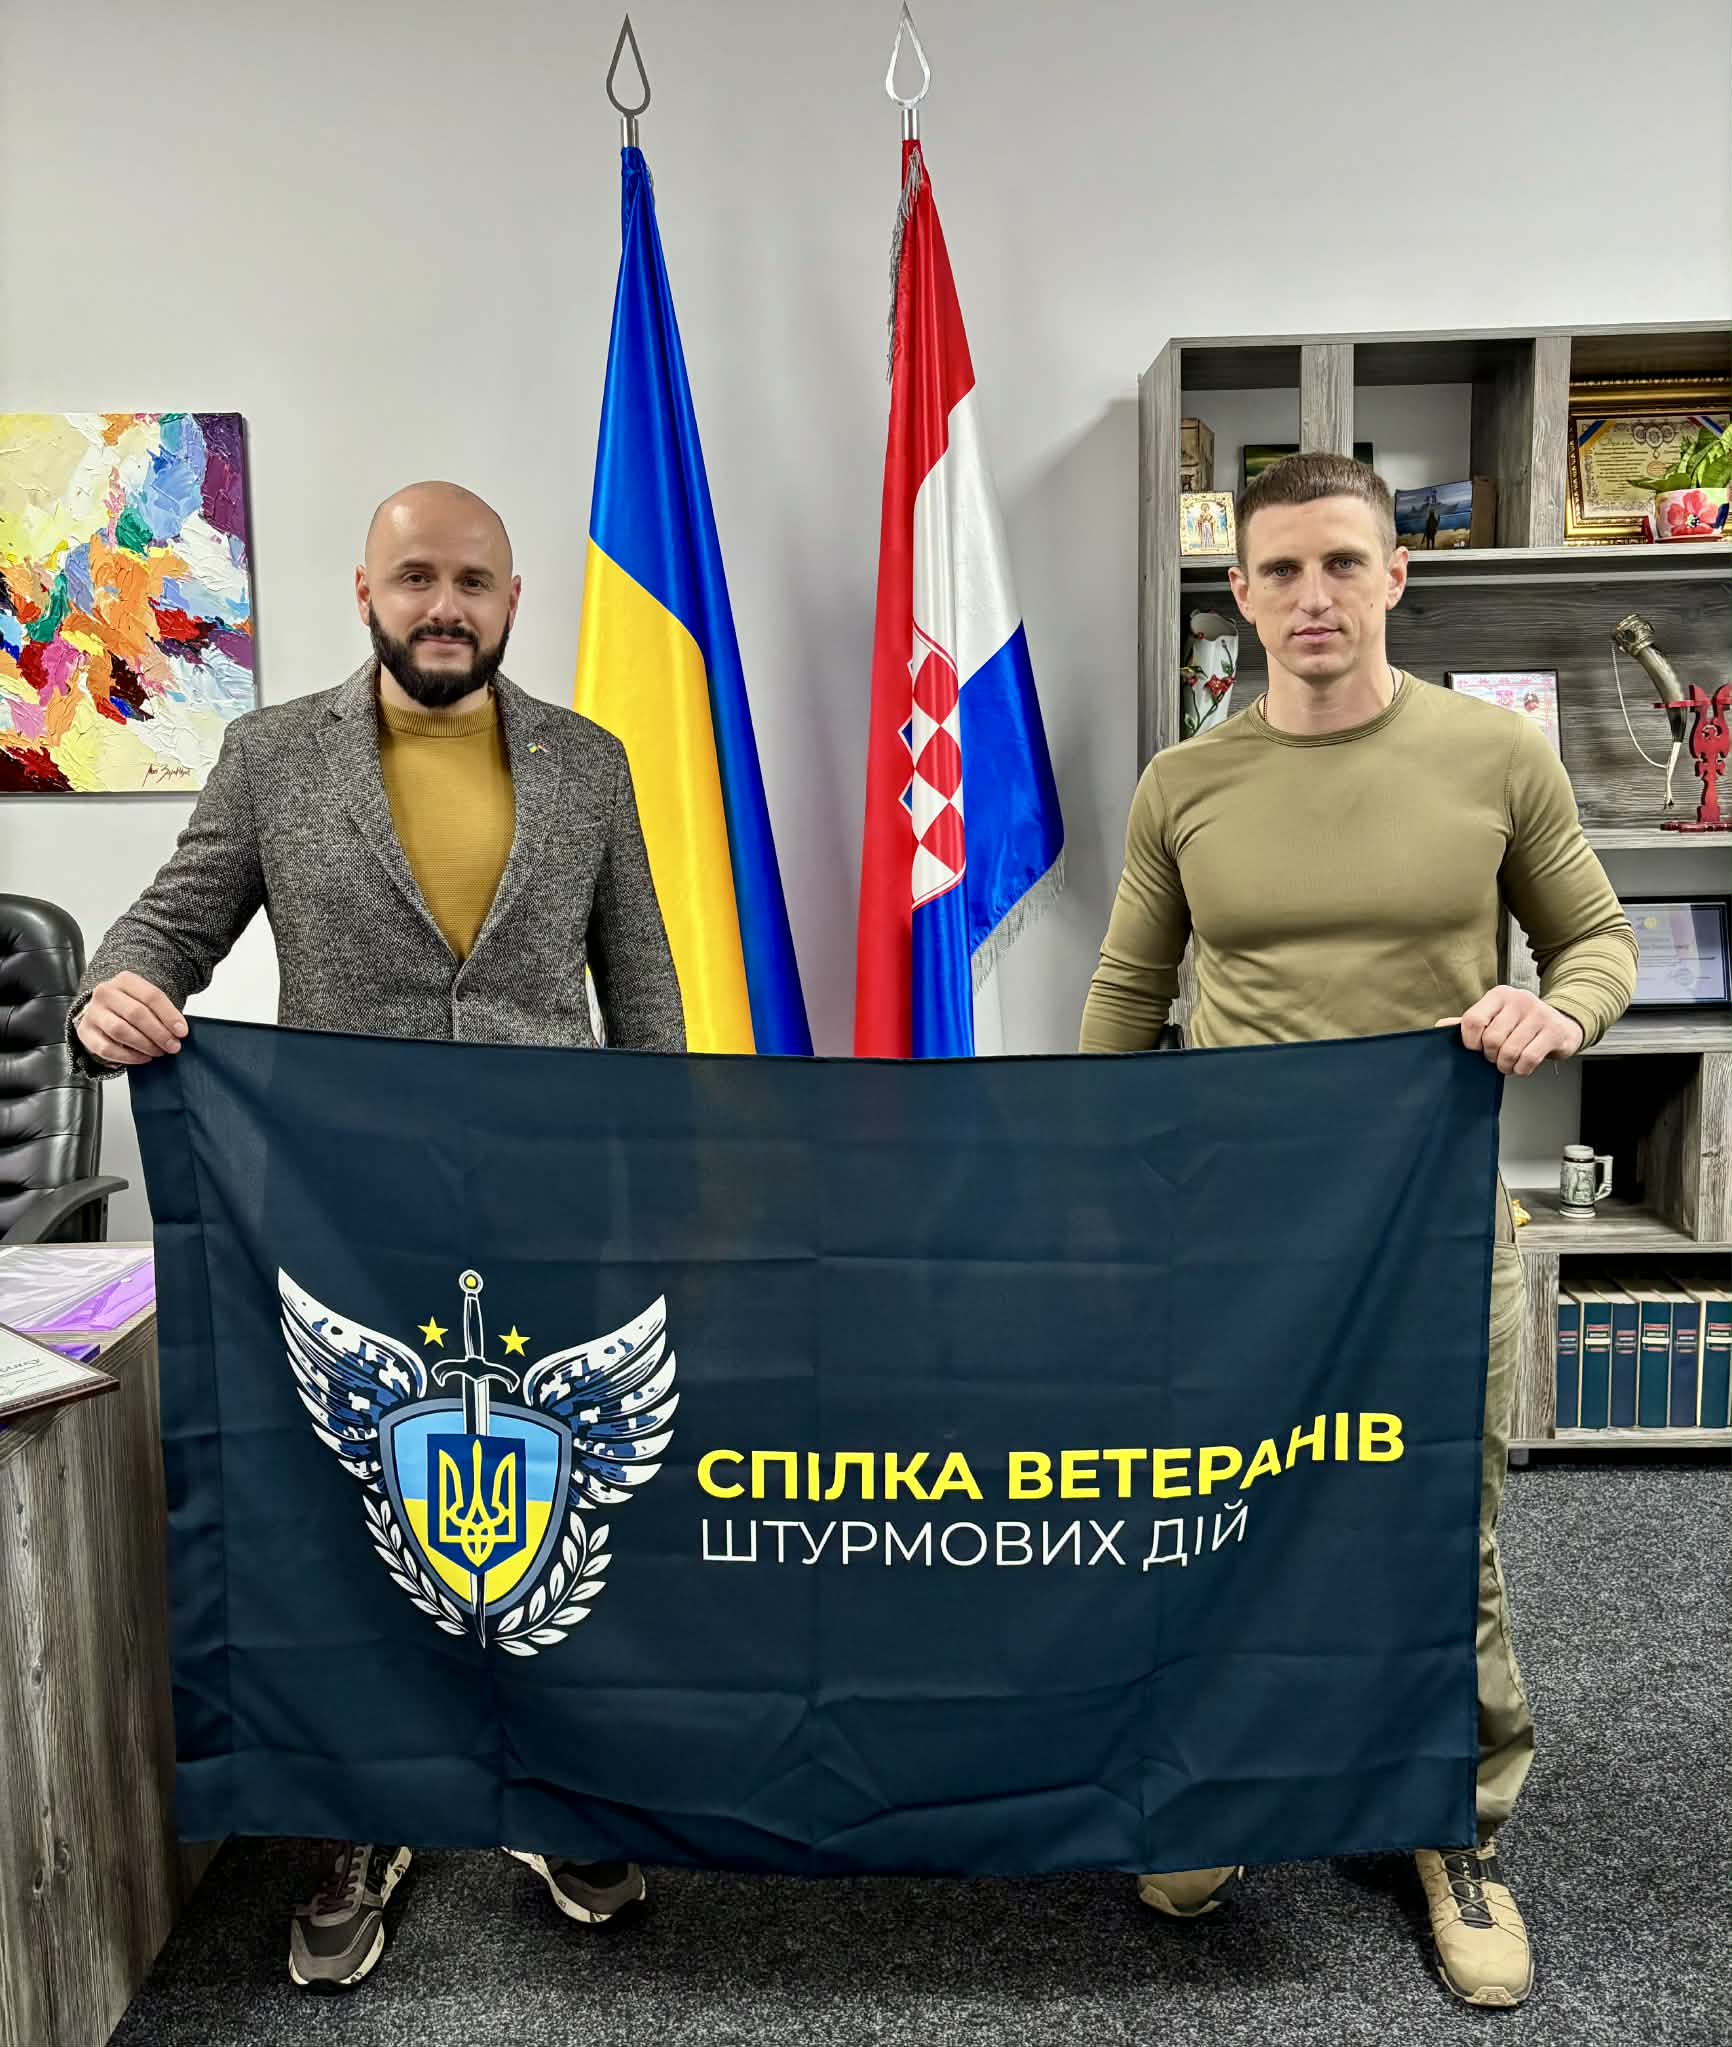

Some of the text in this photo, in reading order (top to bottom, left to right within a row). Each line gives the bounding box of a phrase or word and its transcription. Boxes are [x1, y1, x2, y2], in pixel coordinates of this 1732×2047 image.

[698, 1412, 1405, 1501] СПІЛКА ВЕТЕРАНІВ
[702, 1499, 1248, 1571] ШТУРМОВИХ ДІЙ
